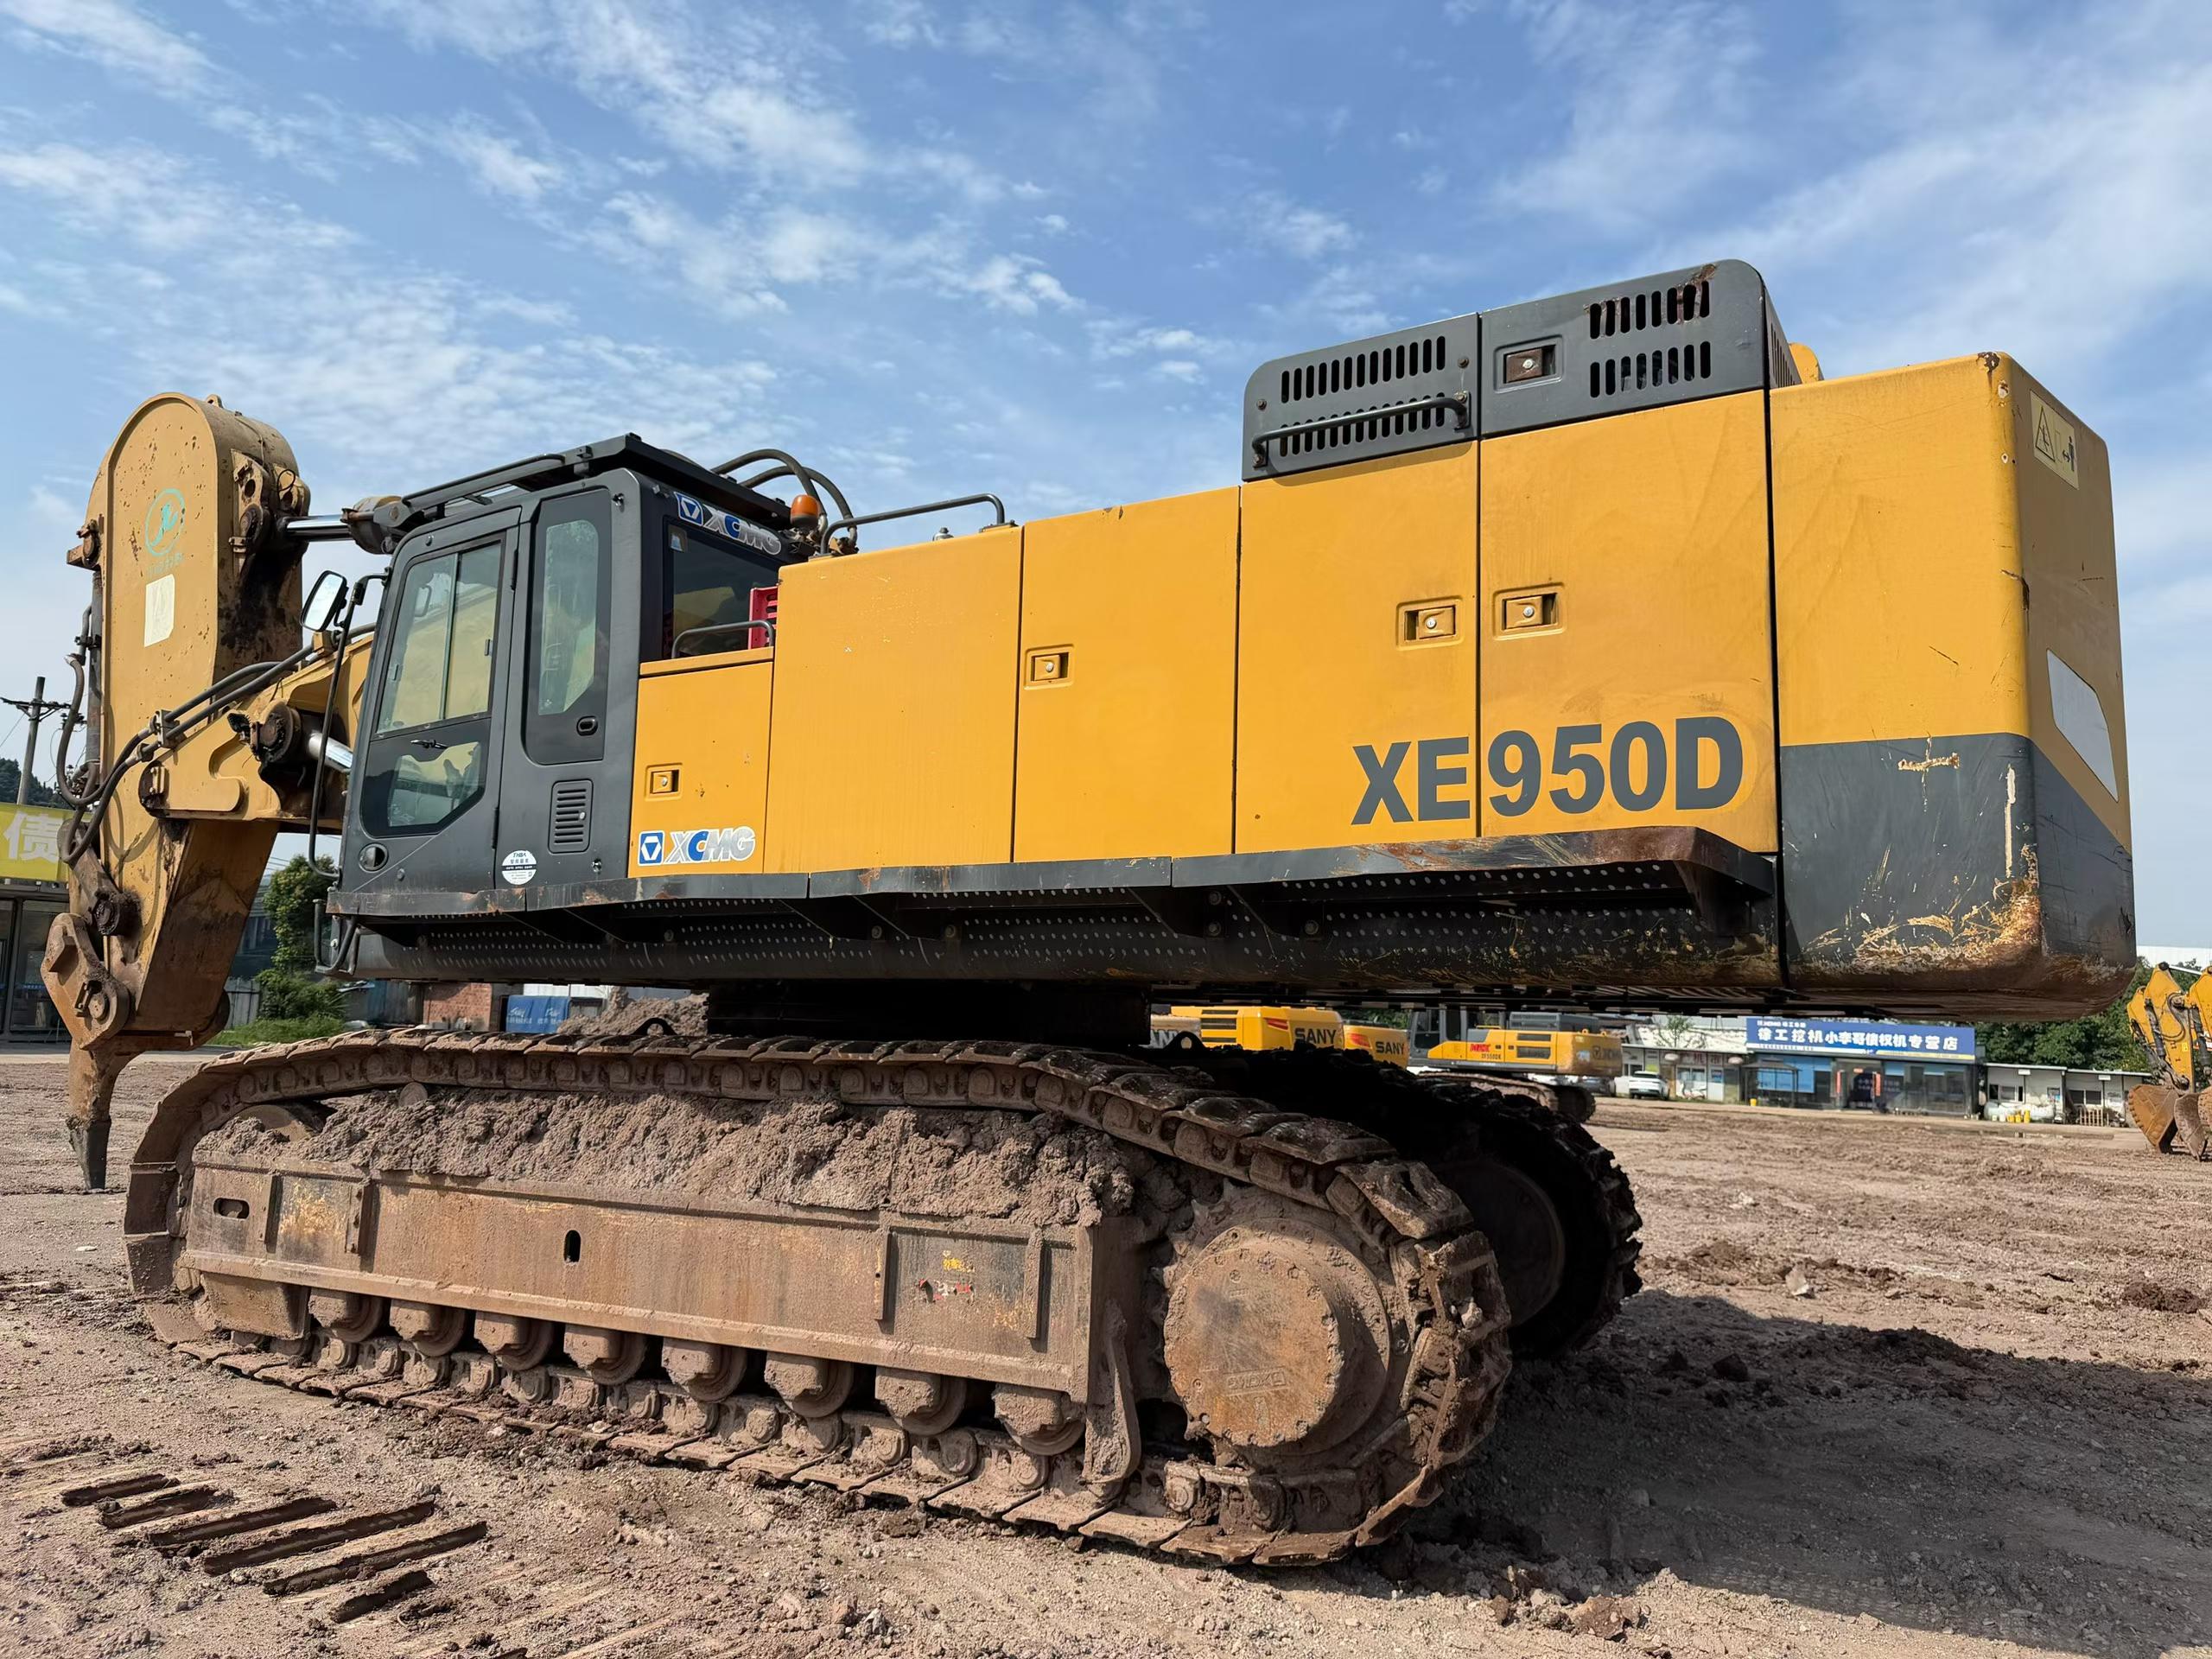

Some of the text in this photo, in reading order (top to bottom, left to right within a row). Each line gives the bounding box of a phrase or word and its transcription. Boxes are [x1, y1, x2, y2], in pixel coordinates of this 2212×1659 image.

[702, 504, 781, 556] XCMG
[1350, 715, 1744, 826] XE950D
[662, 825, 756, 864] XCMG
[1294, 1027, 1337, 1045] SANY
[1375, 1041, 1405, 1055] SANY
